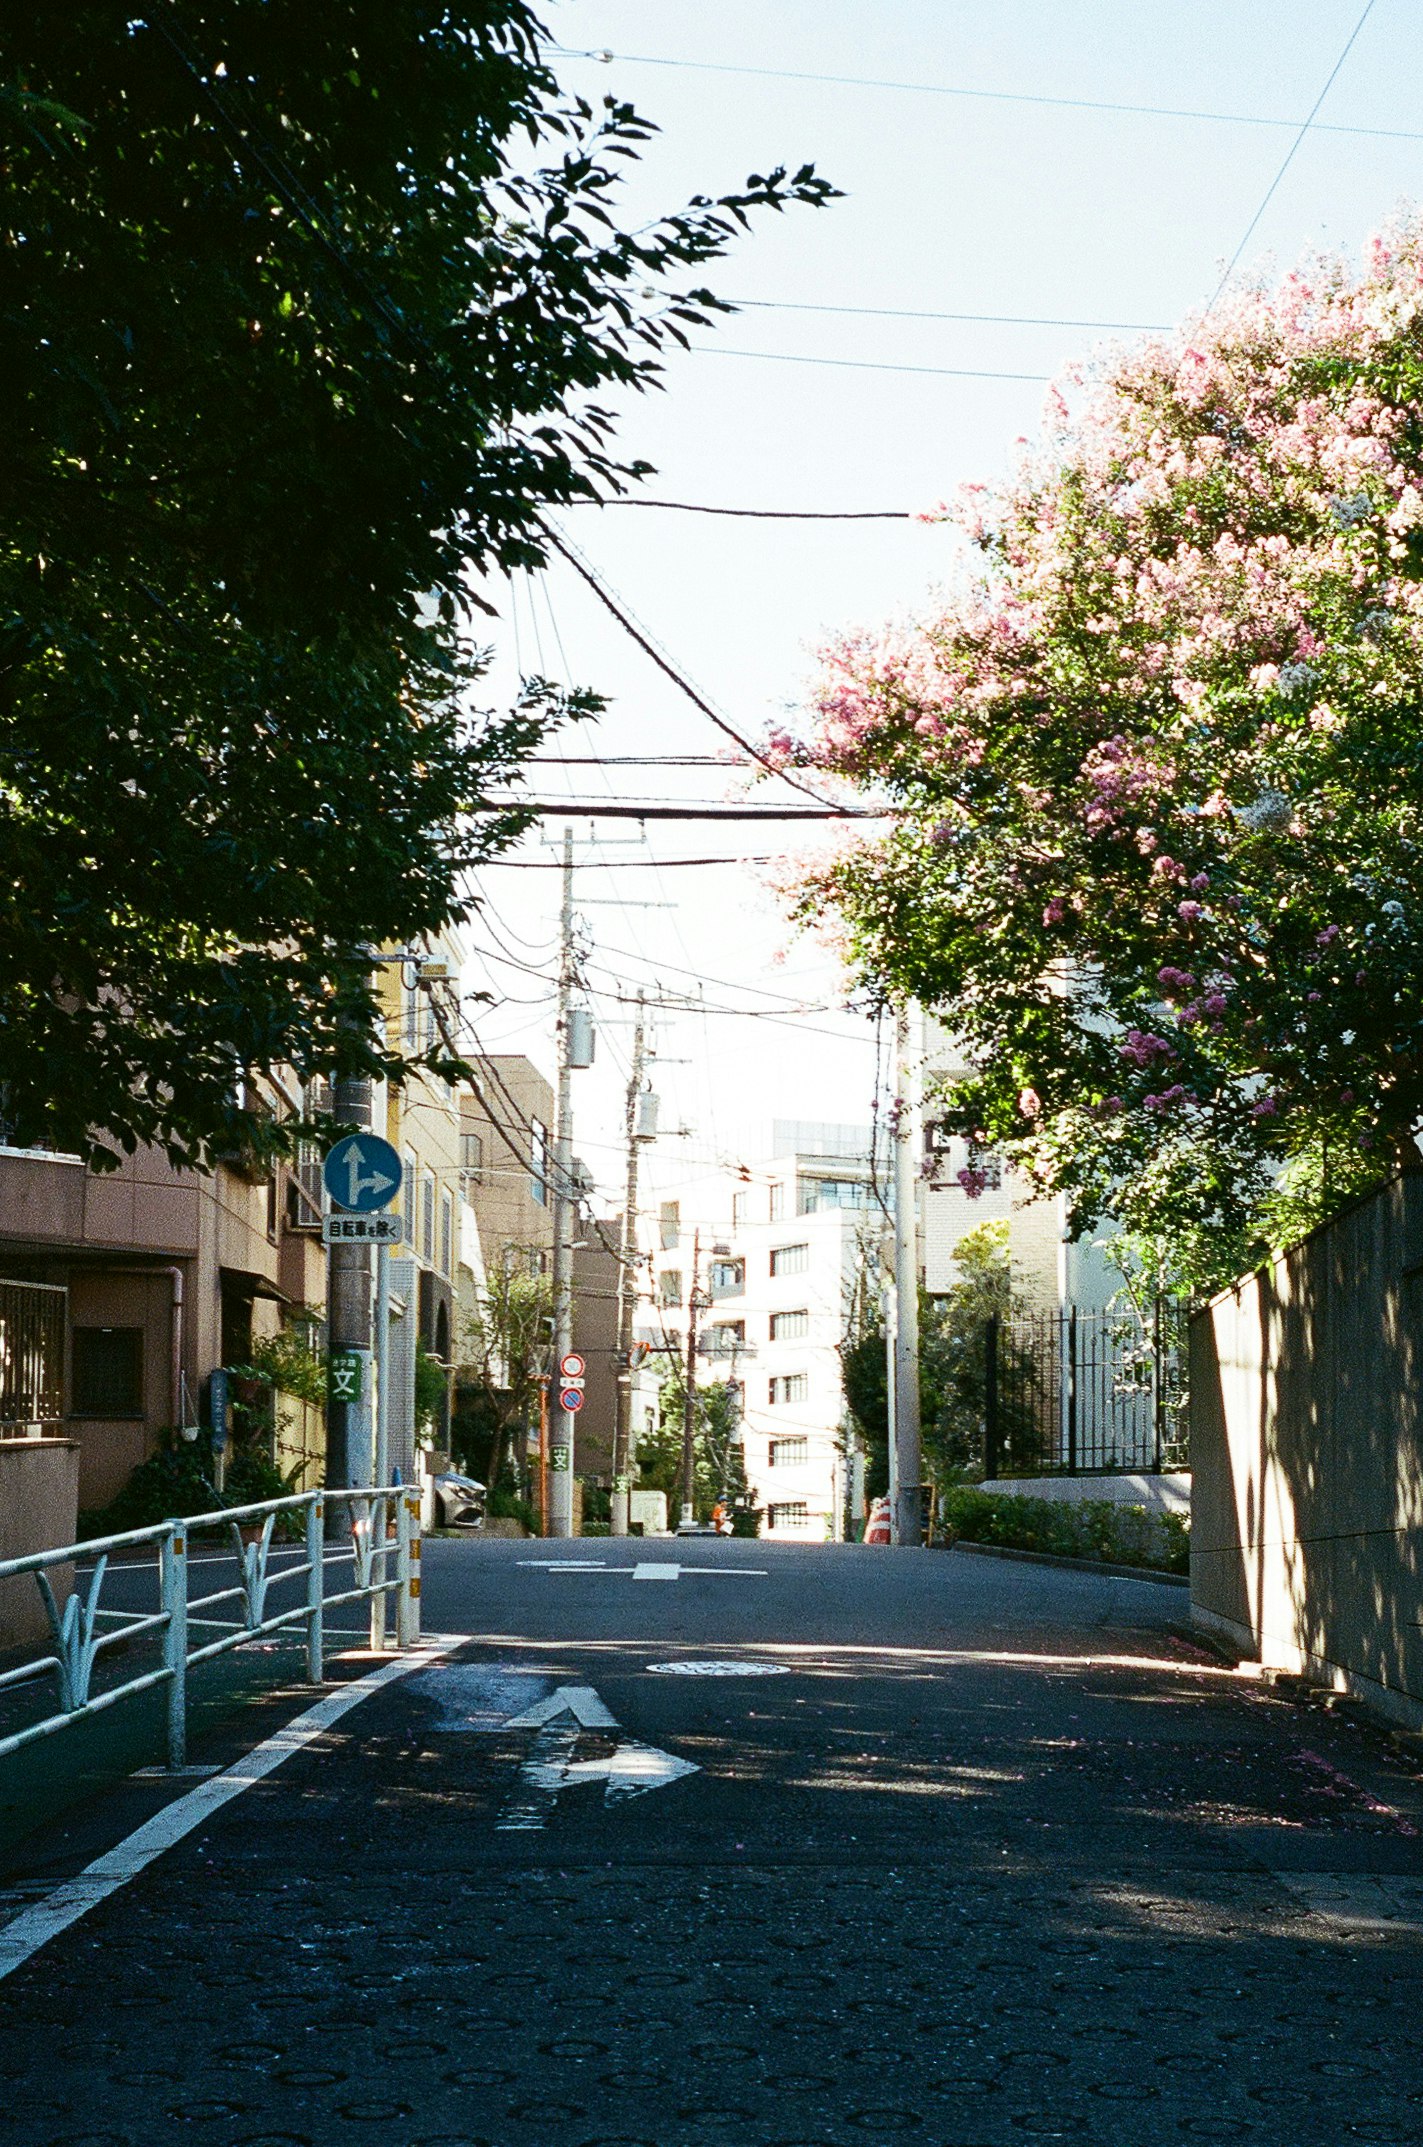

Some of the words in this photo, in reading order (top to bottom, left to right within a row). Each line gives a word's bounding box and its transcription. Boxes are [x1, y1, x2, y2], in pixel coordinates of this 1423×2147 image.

[329, 1220, 397, 1237] 自転車を除く
[332, 1368, 356, 1394] 文
[554, 1453, 567, 1468] 文
